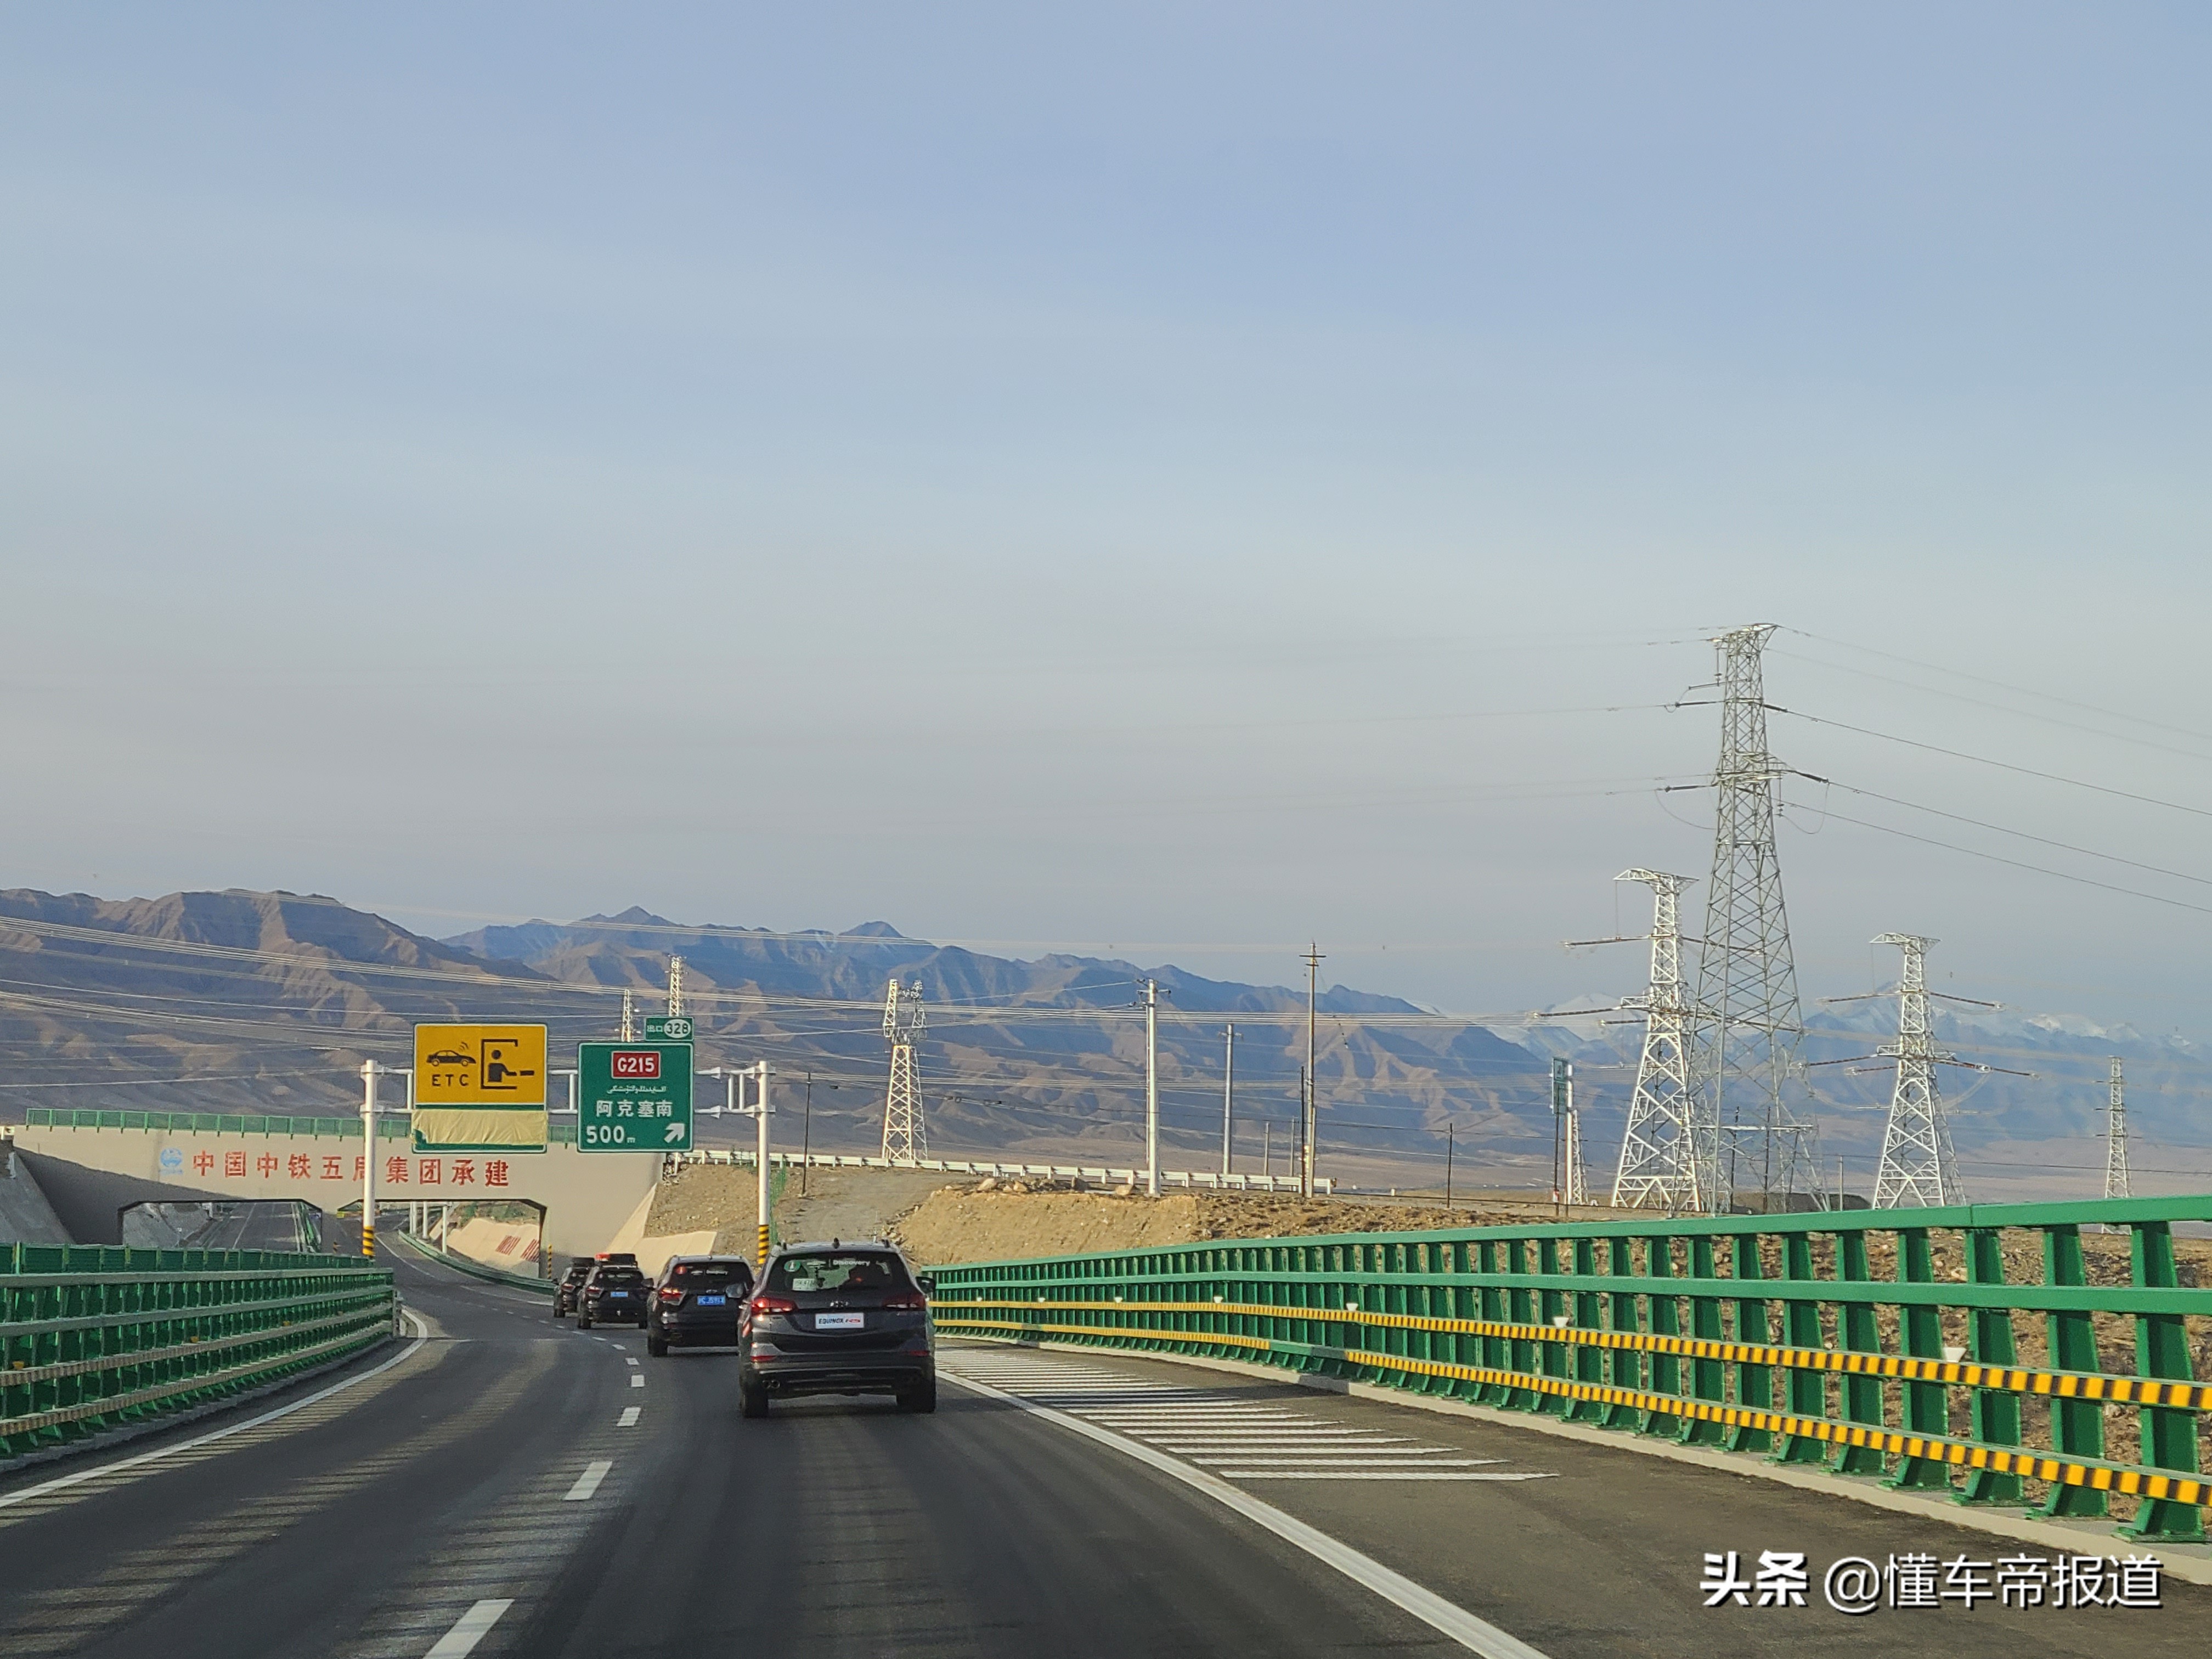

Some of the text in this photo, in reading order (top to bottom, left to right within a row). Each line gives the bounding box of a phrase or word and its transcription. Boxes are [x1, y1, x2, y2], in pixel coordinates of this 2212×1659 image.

[666, 1023, 689, 1034] 328
[617, 1057, 654, 1073] G215
[432, 1074, 469, 1087] ETC
[596, 1099, 673, 1118] 阿克塞南
[586, 1125, 625, 1144] 500
